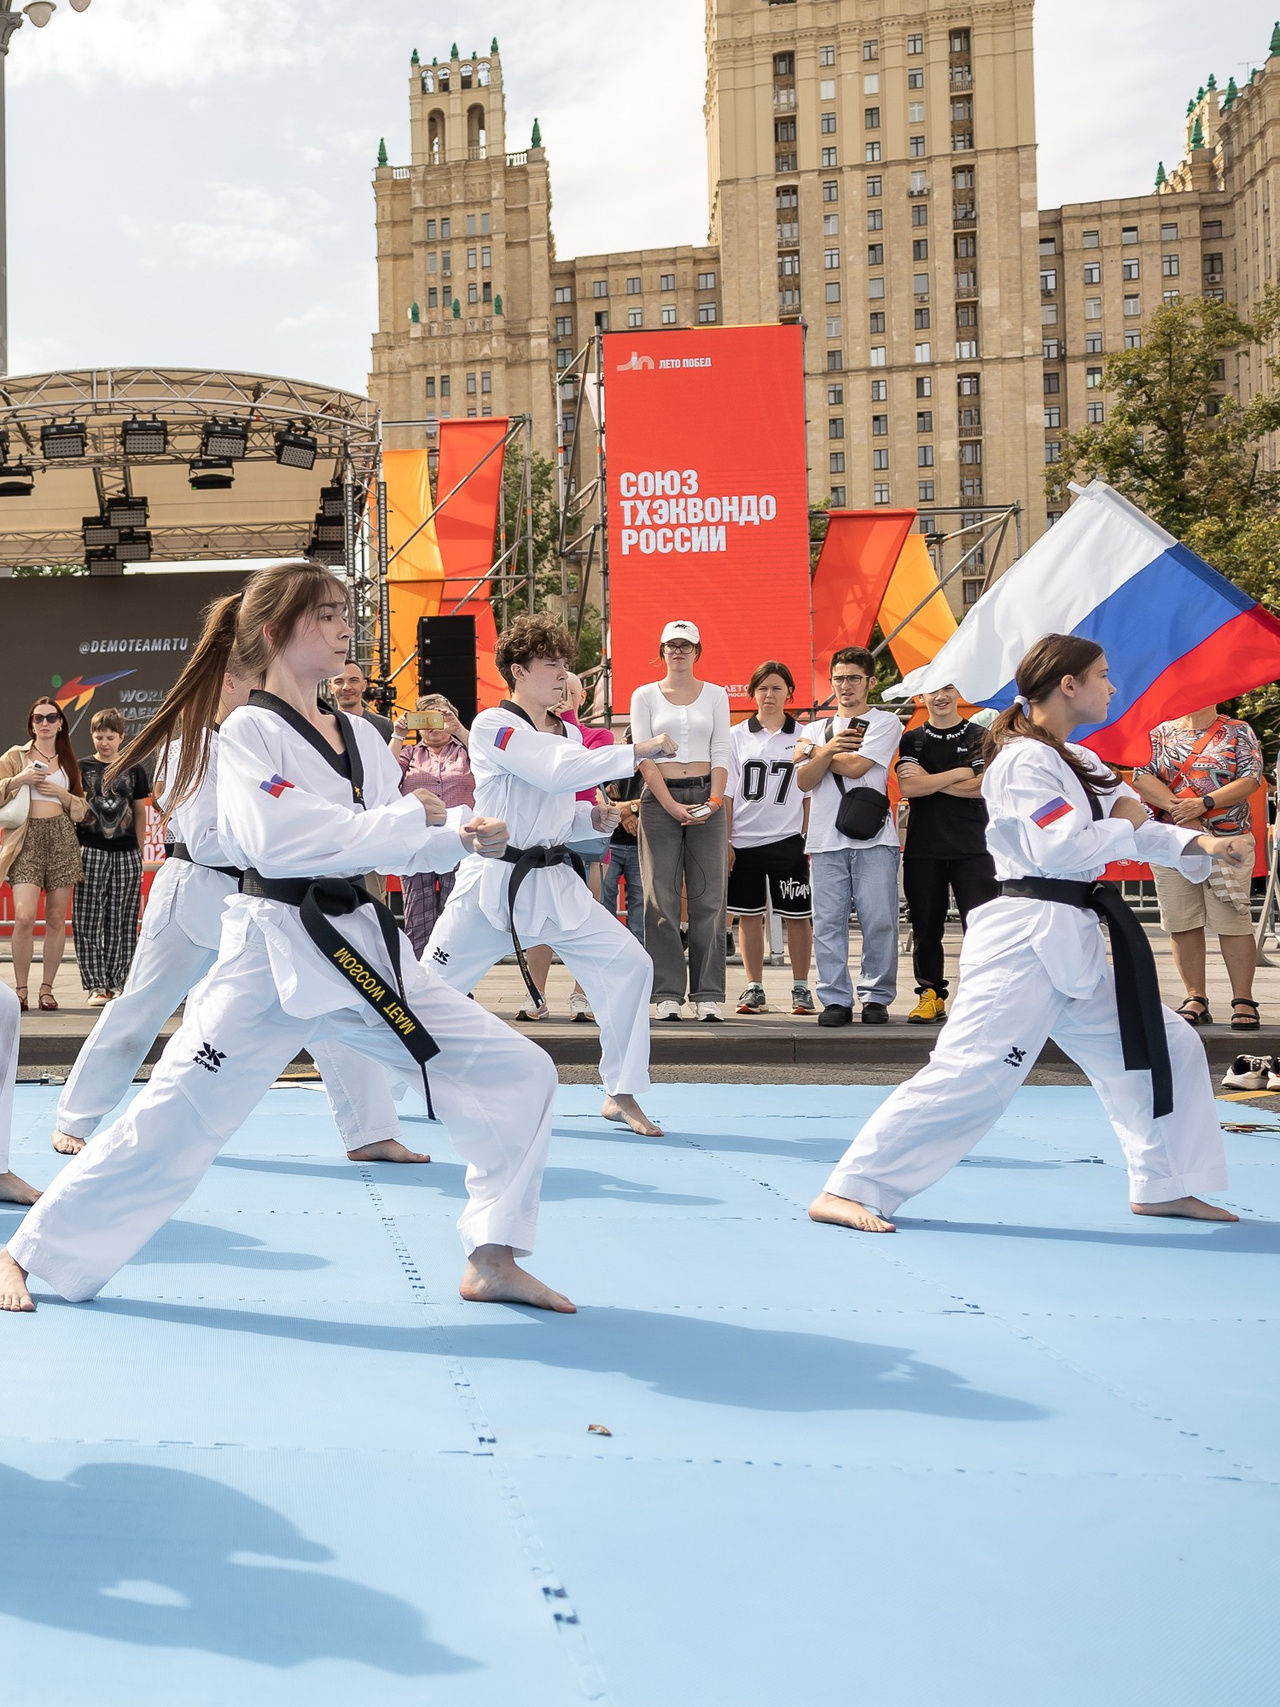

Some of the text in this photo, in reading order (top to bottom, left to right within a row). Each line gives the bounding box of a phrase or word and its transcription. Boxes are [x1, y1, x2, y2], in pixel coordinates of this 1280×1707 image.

[659, 357, 712, 369] ЛЕТО ПОБЕД
[620, 469, 699, 498] СОЮЗ
[620, 494, 777, 526] ТХЭКВОНДО
[621, 525, 727, 555] РОССИИ
[79, 638, 188, 654] @DEMOTEAMRTU
[120, 689, 166, 702] WORL
[741, 758, 798, 806] 07
[193, 1056, 218, 1073] KPNP
